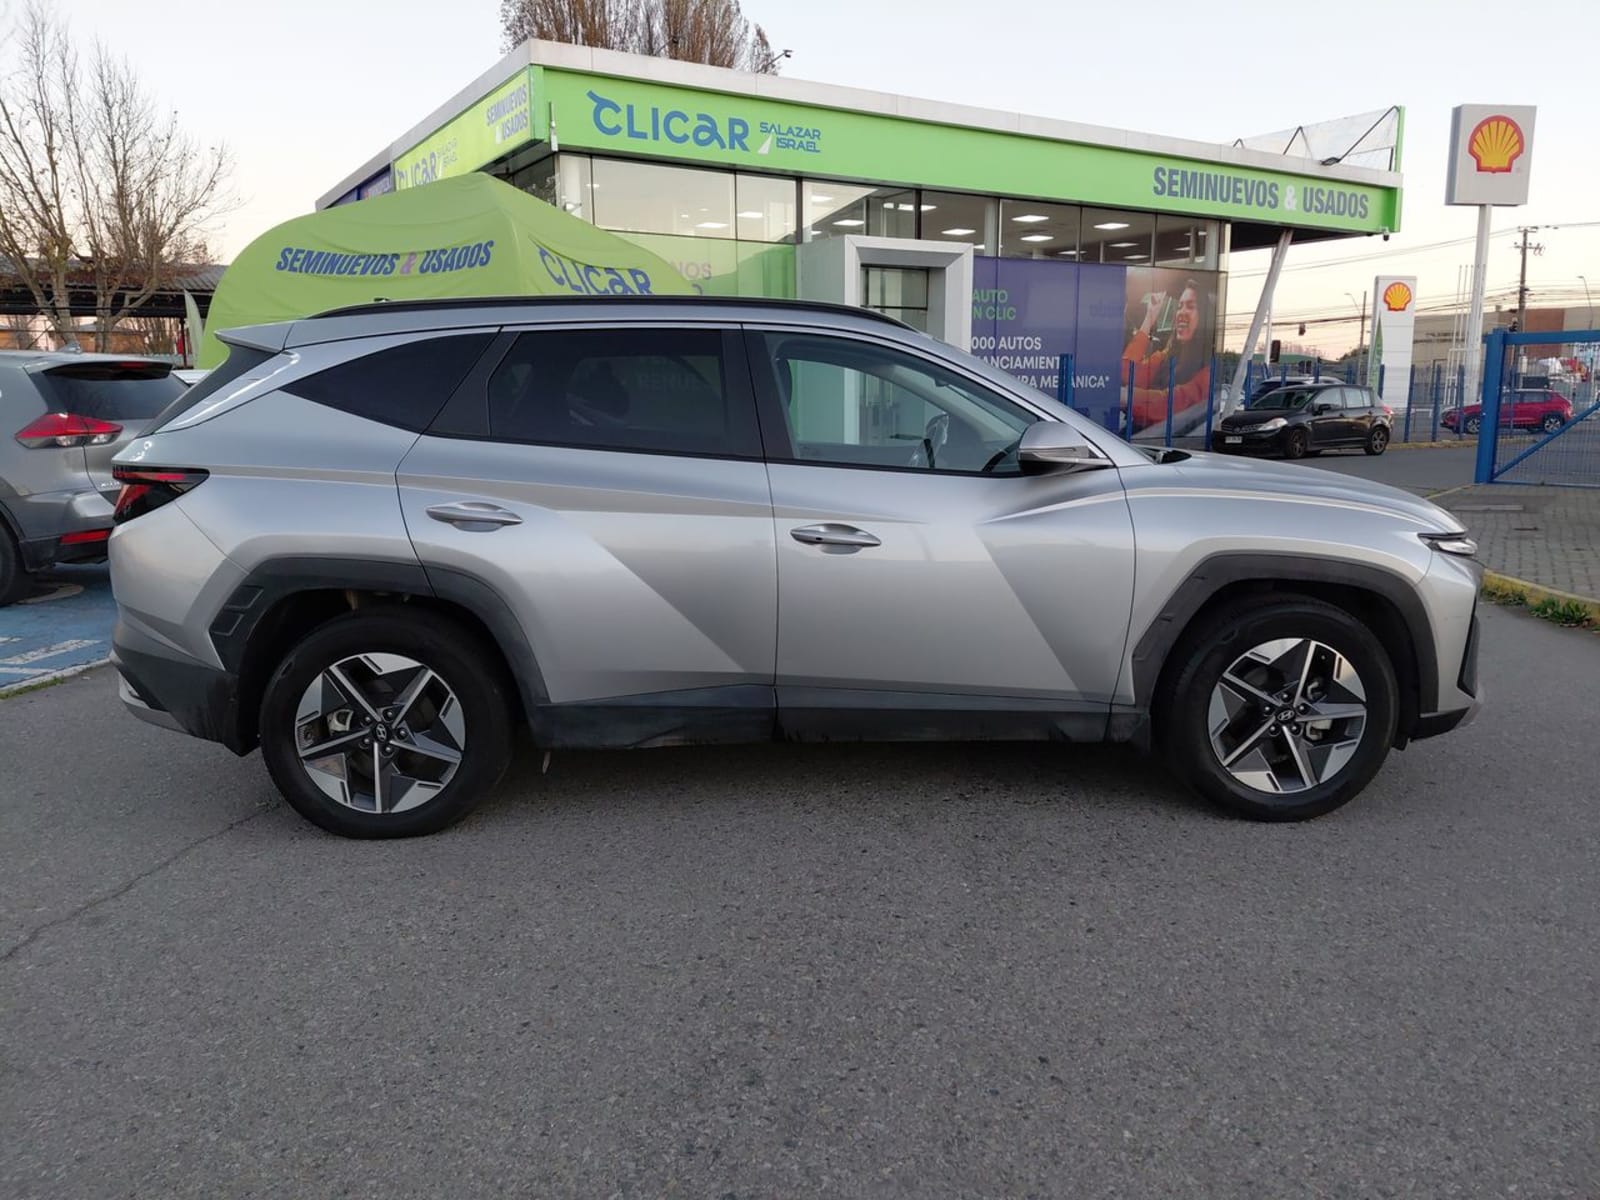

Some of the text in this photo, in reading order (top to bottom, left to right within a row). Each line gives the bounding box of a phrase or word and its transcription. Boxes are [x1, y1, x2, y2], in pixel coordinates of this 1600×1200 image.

[760, 122, 821, 140] SALAZAR
[777, 137, 821, 152] ISRAEL
[1153, 166, 1369, 219] SEMINUEVOS & USADOS
[276, 247, 400, 276] SEMINUEVOS
[420, 240, 494, 274] USADOS
[972, 289, 1009, 303] AUTO
[985, 305, 1017, 320] CLIC
[998, 336, 1042, 350] AUTOS
[975, 356, 1060, 370] NCIAMIENT
